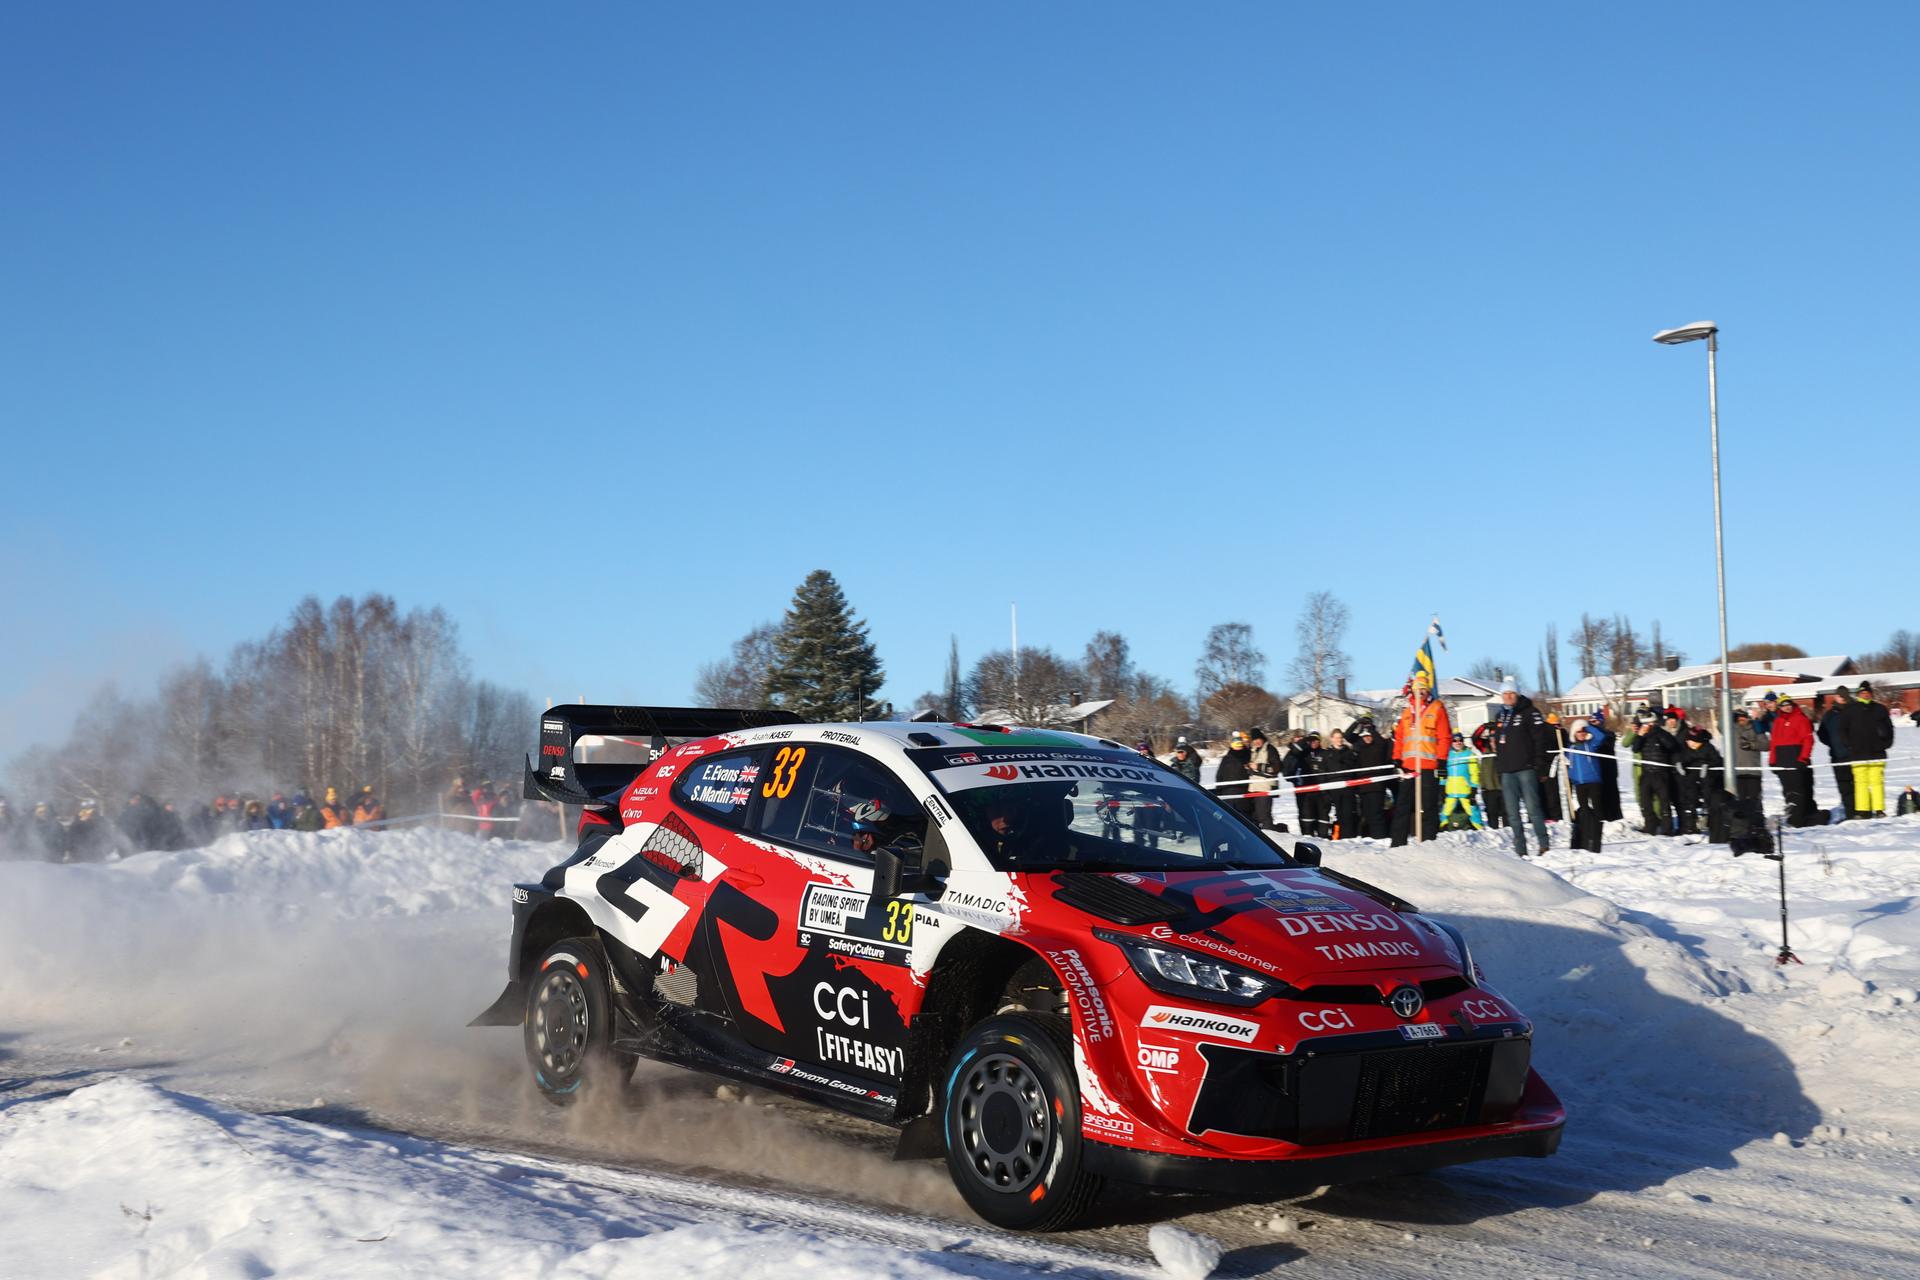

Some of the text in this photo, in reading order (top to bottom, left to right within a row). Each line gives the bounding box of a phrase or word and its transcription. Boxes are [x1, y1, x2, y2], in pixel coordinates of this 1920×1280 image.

[821, 731, 862, 746] PROTERIAL
[543, 745, 565, 757] DENSO
[950, 755, 979, 765] GR
[982, 753, 1047, 761] TOYOTA
[702, 765, 740, 783] E.Evans
[762, 746, 806, 799] 33
[690, 785, 731, 805] S.Martin
[925, 795, 947, 825] CENTRAL
[811, 892, 865, 913] RACING SPIRIT
[948, 890, 1006, 912] TAMADIC
[809, 909, 818, 922] BY
[882, 900, 913, 944] 33
[914, 913, 940, 928] PIAA
[1277, 914, 1400, 936] DENSO
[801, 933, 811, 944] SC
[828, 938, 885, 958] SafetyCulture
[1178, 934, 1280, 972] codebeamer
[1314, 941, 1420, 960] TAMADIC
[1046, 951, 1101, 1042] AUTOMOTIVE
[1062, 949, 1114, 1039] Panasonic
[1138, 1049, 1179, 1069] OMP
[790, 1069, 828, 1085] TOYOTA
